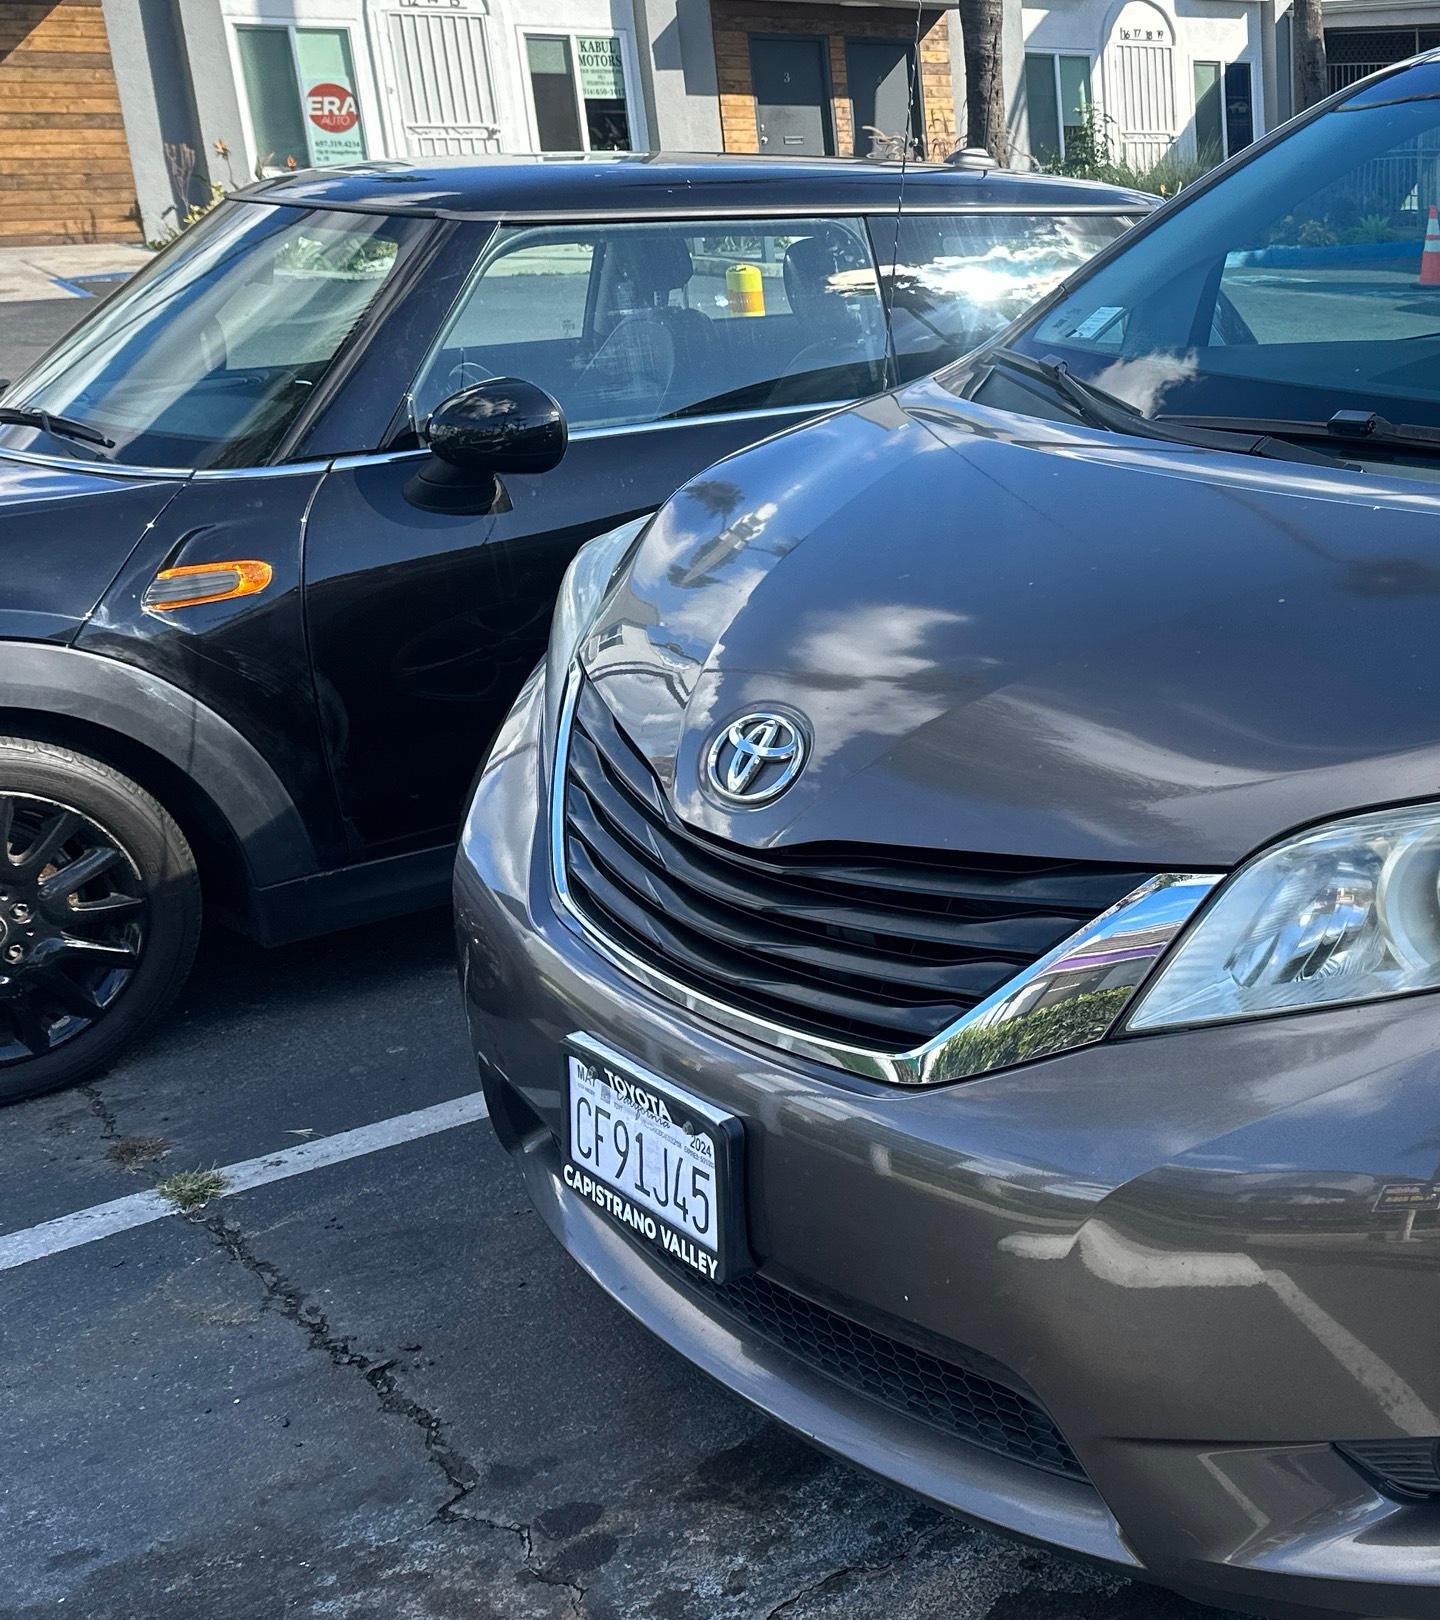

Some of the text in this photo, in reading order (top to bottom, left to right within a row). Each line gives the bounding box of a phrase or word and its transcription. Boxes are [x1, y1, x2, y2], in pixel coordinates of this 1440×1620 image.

[579, 40, 616, 53] KABUL
[578, 54, 623, 67] MOTORS
[783, 72, 791, 83] 3
[306, 95, 357, 116] ERA
[320, 115, 351, 126] AUTO
[603, 1067, 672, 1122] TOYOTA
[688, 1134, 712, 1159] 2024
[577, 1097, 710, 1234] CF91J45
[563, 1165, 718, 1280] CAPISTRANO VALLEY
